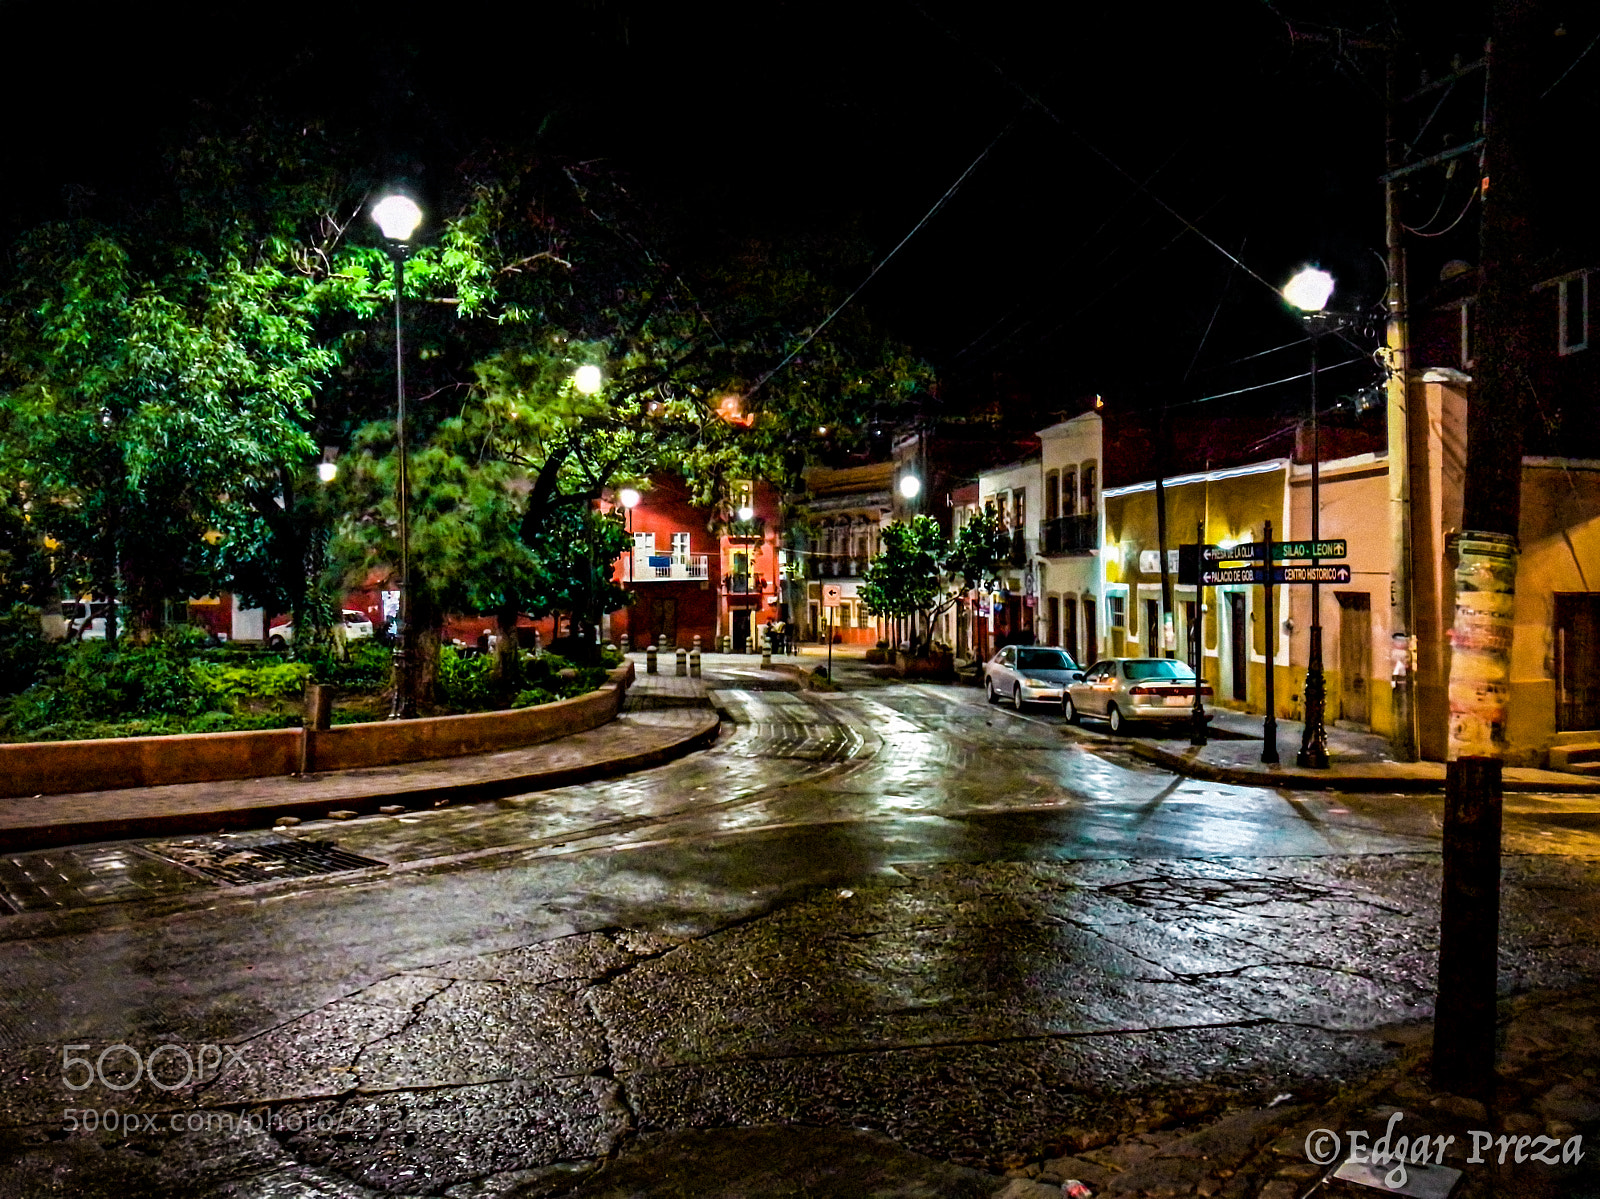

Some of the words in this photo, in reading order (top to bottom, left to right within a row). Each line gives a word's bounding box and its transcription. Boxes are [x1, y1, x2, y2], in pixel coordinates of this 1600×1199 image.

[1235, 547, 1241, 558] LA
[1241, 546, 1254, 558] OLLA
[1283, 544, 1305, 556] SILAO
[1312, 543, 1333, 556] LEON
[1211, 570, 1233, 583] PALACIO
[1233, 570, 1241, 582] DE
[1284, 568, 1306, 581] CENTRO
[1306, 567, 1337, 581] HISTORICO
